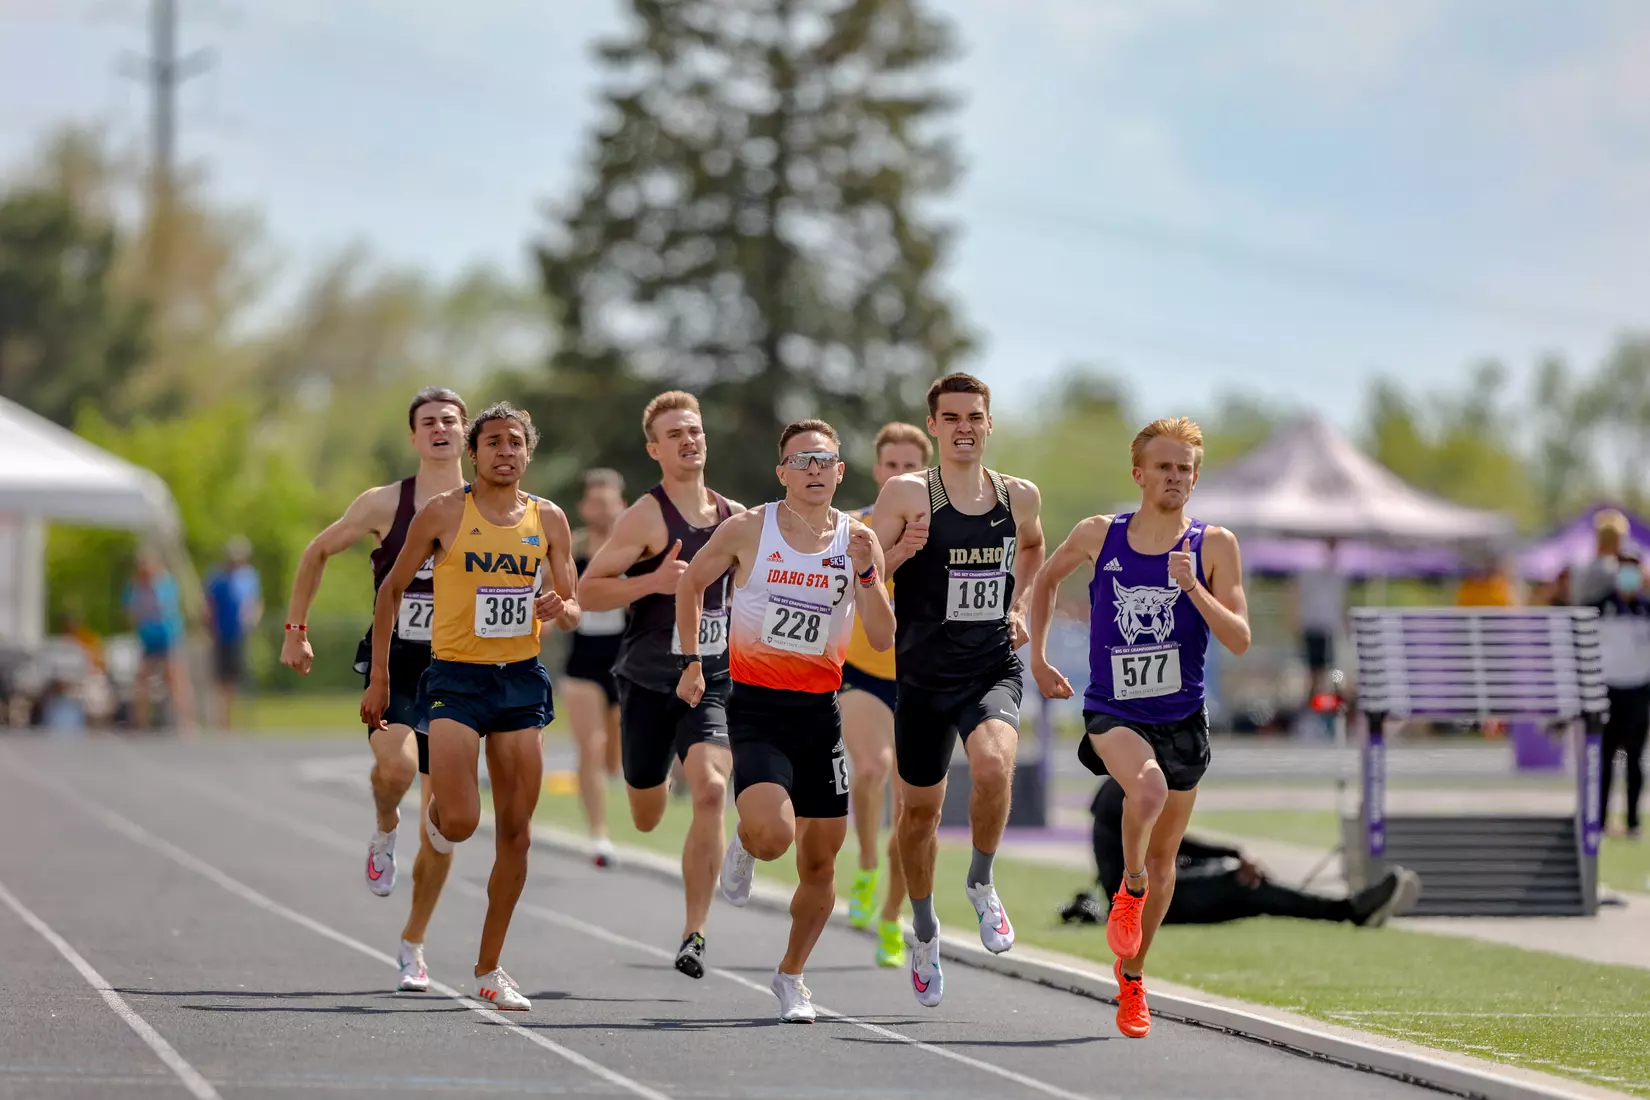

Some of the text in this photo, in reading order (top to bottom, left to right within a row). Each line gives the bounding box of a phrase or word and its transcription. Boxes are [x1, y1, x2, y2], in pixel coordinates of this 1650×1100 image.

[464, 552, 541, 577] NAU
[830, 555, 844, 566] SKY
[949, 547, 1004, 564] IDAHO
[767, 569, 829, 589] IDAHO STA
[832, 574, 848, 606] 3
[958, 580, 999, 609] 183
[409, 602, 434, 628] 27
[485, 597, 527, 626] 385
[771, 607, 821, 643] 228
[1122, 653, 1168, 687] 577
